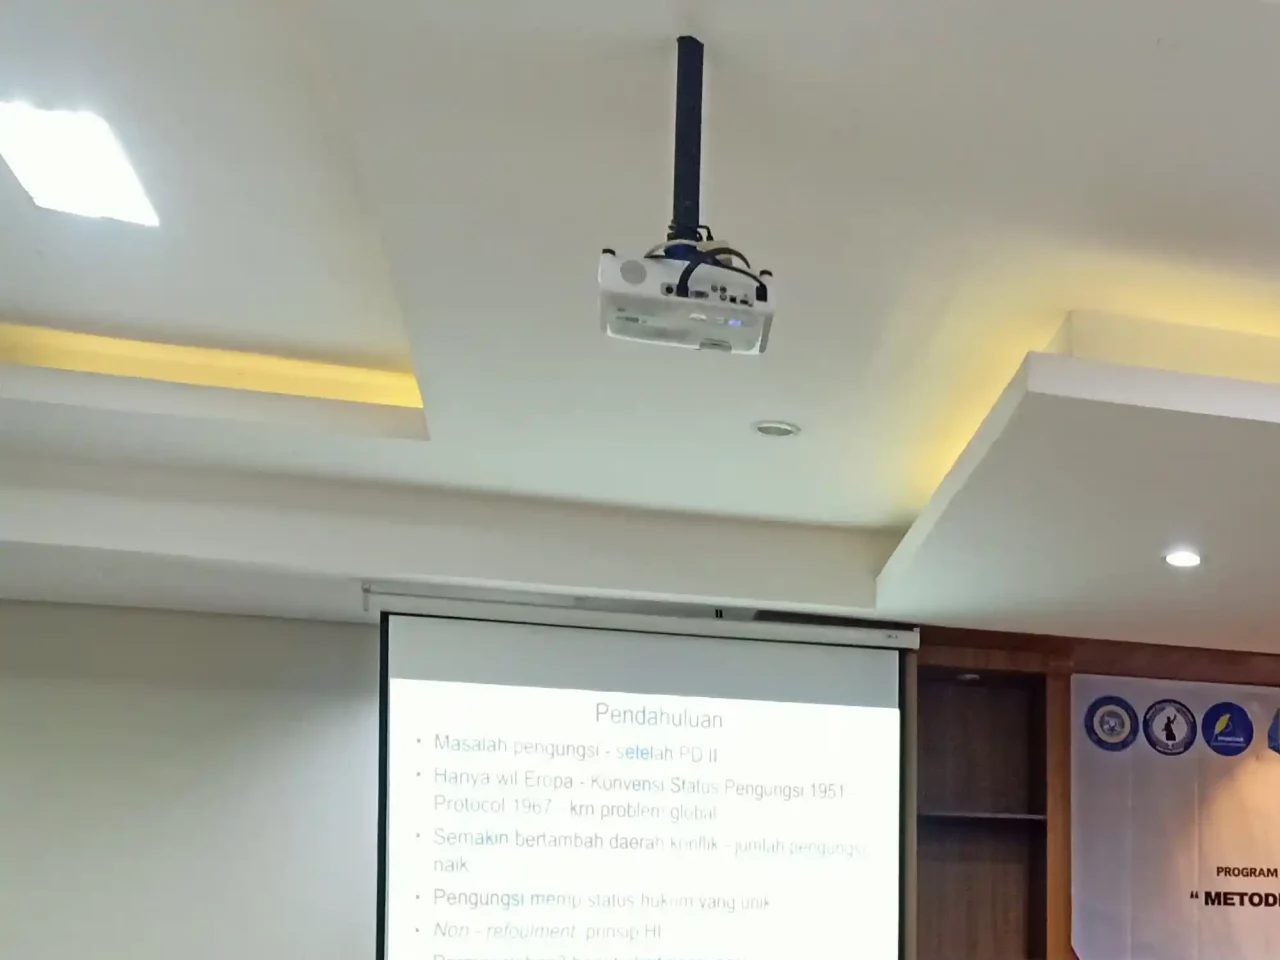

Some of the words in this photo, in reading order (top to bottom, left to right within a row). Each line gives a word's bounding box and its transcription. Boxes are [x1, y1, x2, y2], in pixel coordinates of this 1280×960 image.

[595, 702, 724, 729] Pendahuluan
[434, 733, 507, 753] Masalah
[513, 740, 600, 762] pengungsi
[616, 744, 673, 761] setelah
[433, 767, 490, 788] Hanya
[496, 770, 518, 786] wil
[524, 771, 573, 792] Eropa
[590, 774, 664, 793] Konvensi
[670, 776, 719, 795] Status
[724, 778, 804, 802] Pengungsi
[810, 783, 844, 800] 1951
[433, 795, 505, 814] Protocol
[514, 798, 552, 815] 1967
[671, 804, 717, 824] global
[433, 827, 509, 846] Semakin
[515, 829, 604, 849] bertambah
[609, 833, 664, 851] daerah
[433, 857, 469, 873] naik
[1216, 866, 1278, 878] PROGRAM
[433, 888, 524, 910] Pengungsi
[588, 892, 635, 908] status
[433, 921, 470, 939] Non
